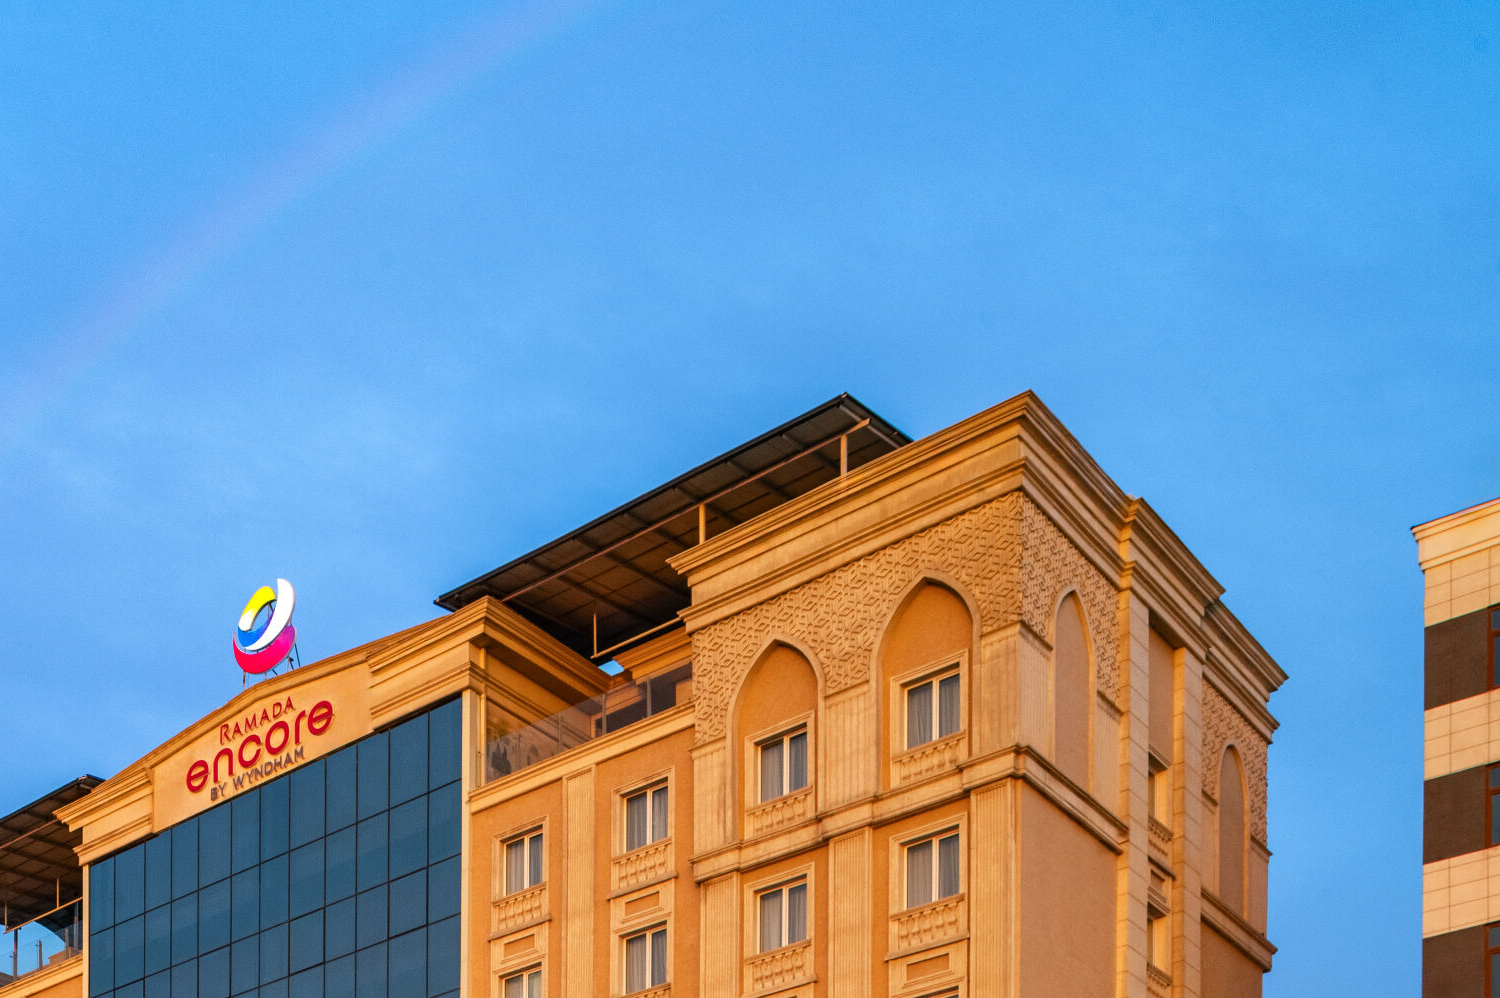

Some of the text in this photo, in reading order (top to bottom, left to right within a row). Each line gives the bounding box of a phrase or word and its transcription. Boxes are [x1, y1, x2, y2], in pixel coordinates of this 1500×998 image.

[186, 700, 334, 793] encore
[219, 696, 296, 745] RAMADA
[210, 746, 305, 801] BY WYNDHAM
